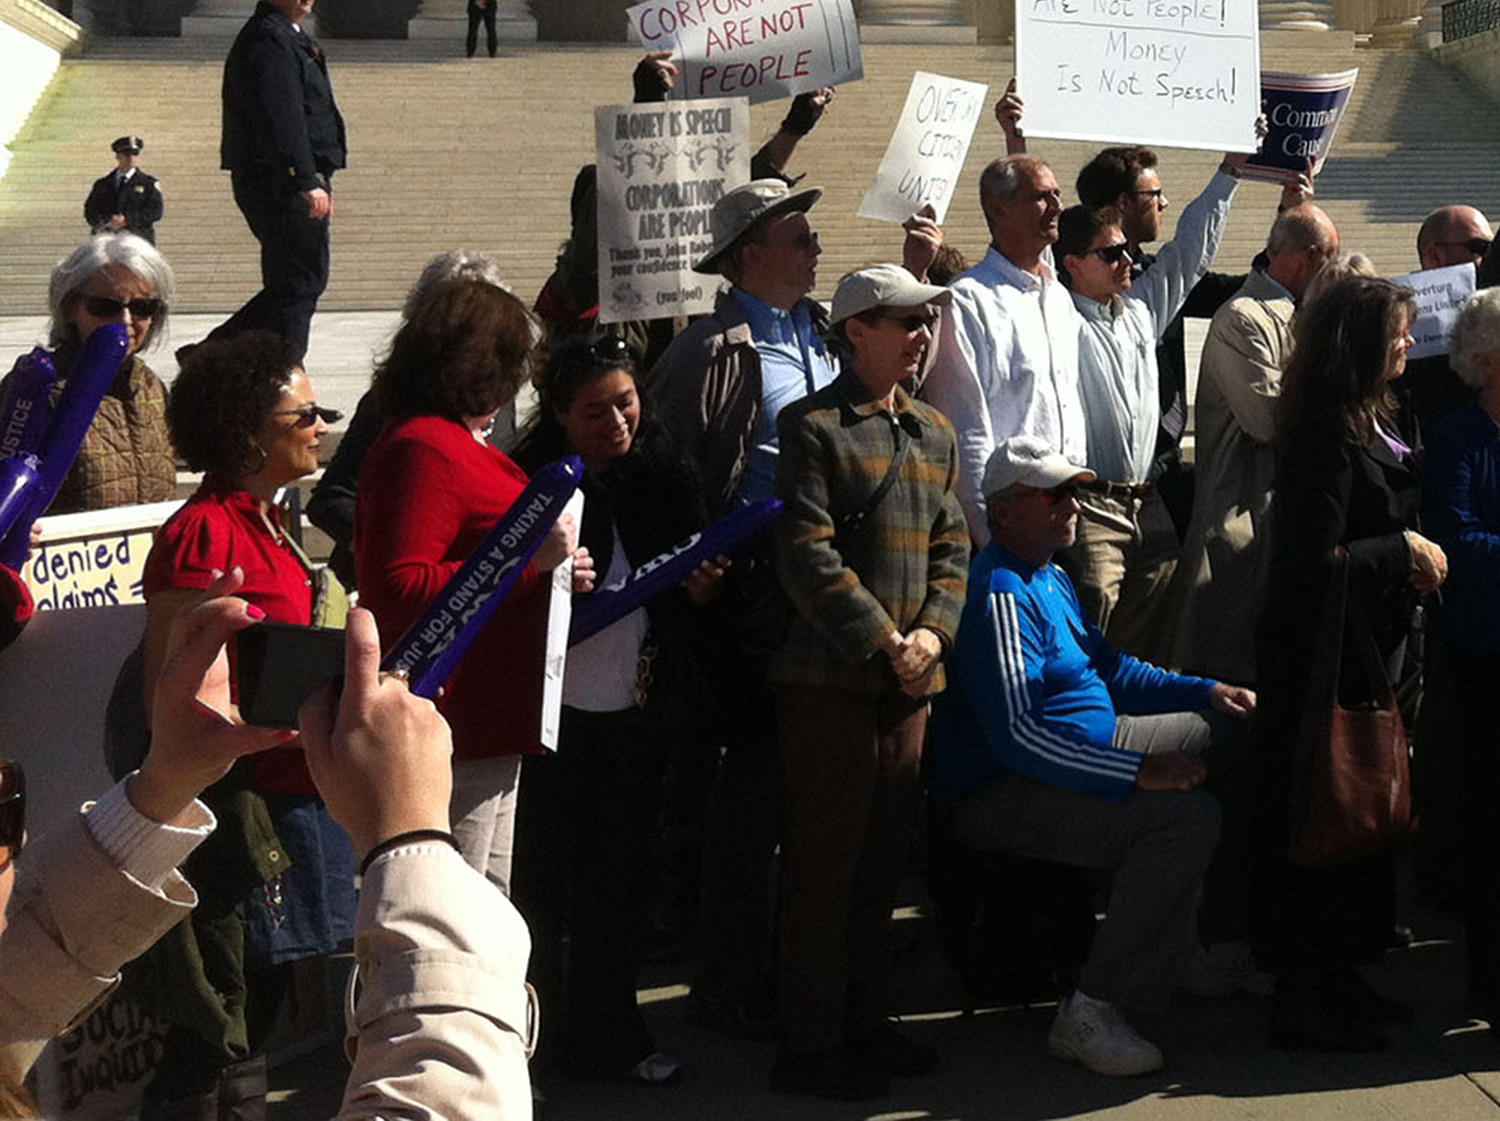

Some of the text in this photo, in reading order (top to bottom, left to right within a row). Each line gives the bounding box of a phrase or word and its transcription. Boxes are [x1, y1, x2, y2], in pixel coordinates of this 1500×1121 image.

[705, 3, 813, 58] ARE NOT
[1105, 31, 1187, 72] Money
[699, 50, 813, 95] PEOPLE
[1056, 64, 1083, 93] Is
[1099, 69, 1144, 96] Not
[615, 107, 732, 140] MONEY IS SPEECH
[638, 213, 666, 241] ARE
[610, 247, 641, 262] Thank
[637, 259, 687, 275] confidence
[1416, 283, 1452, 297] verturn
[0, 397, 33, 460] USTICE
[500, 492, 553, 548] TAKING
[33, 535, 131, 584] denied
[487, 549, 505, 561] A
[448, 560, 496, 611] STAND
[420, 609, 453, 648] FOR
